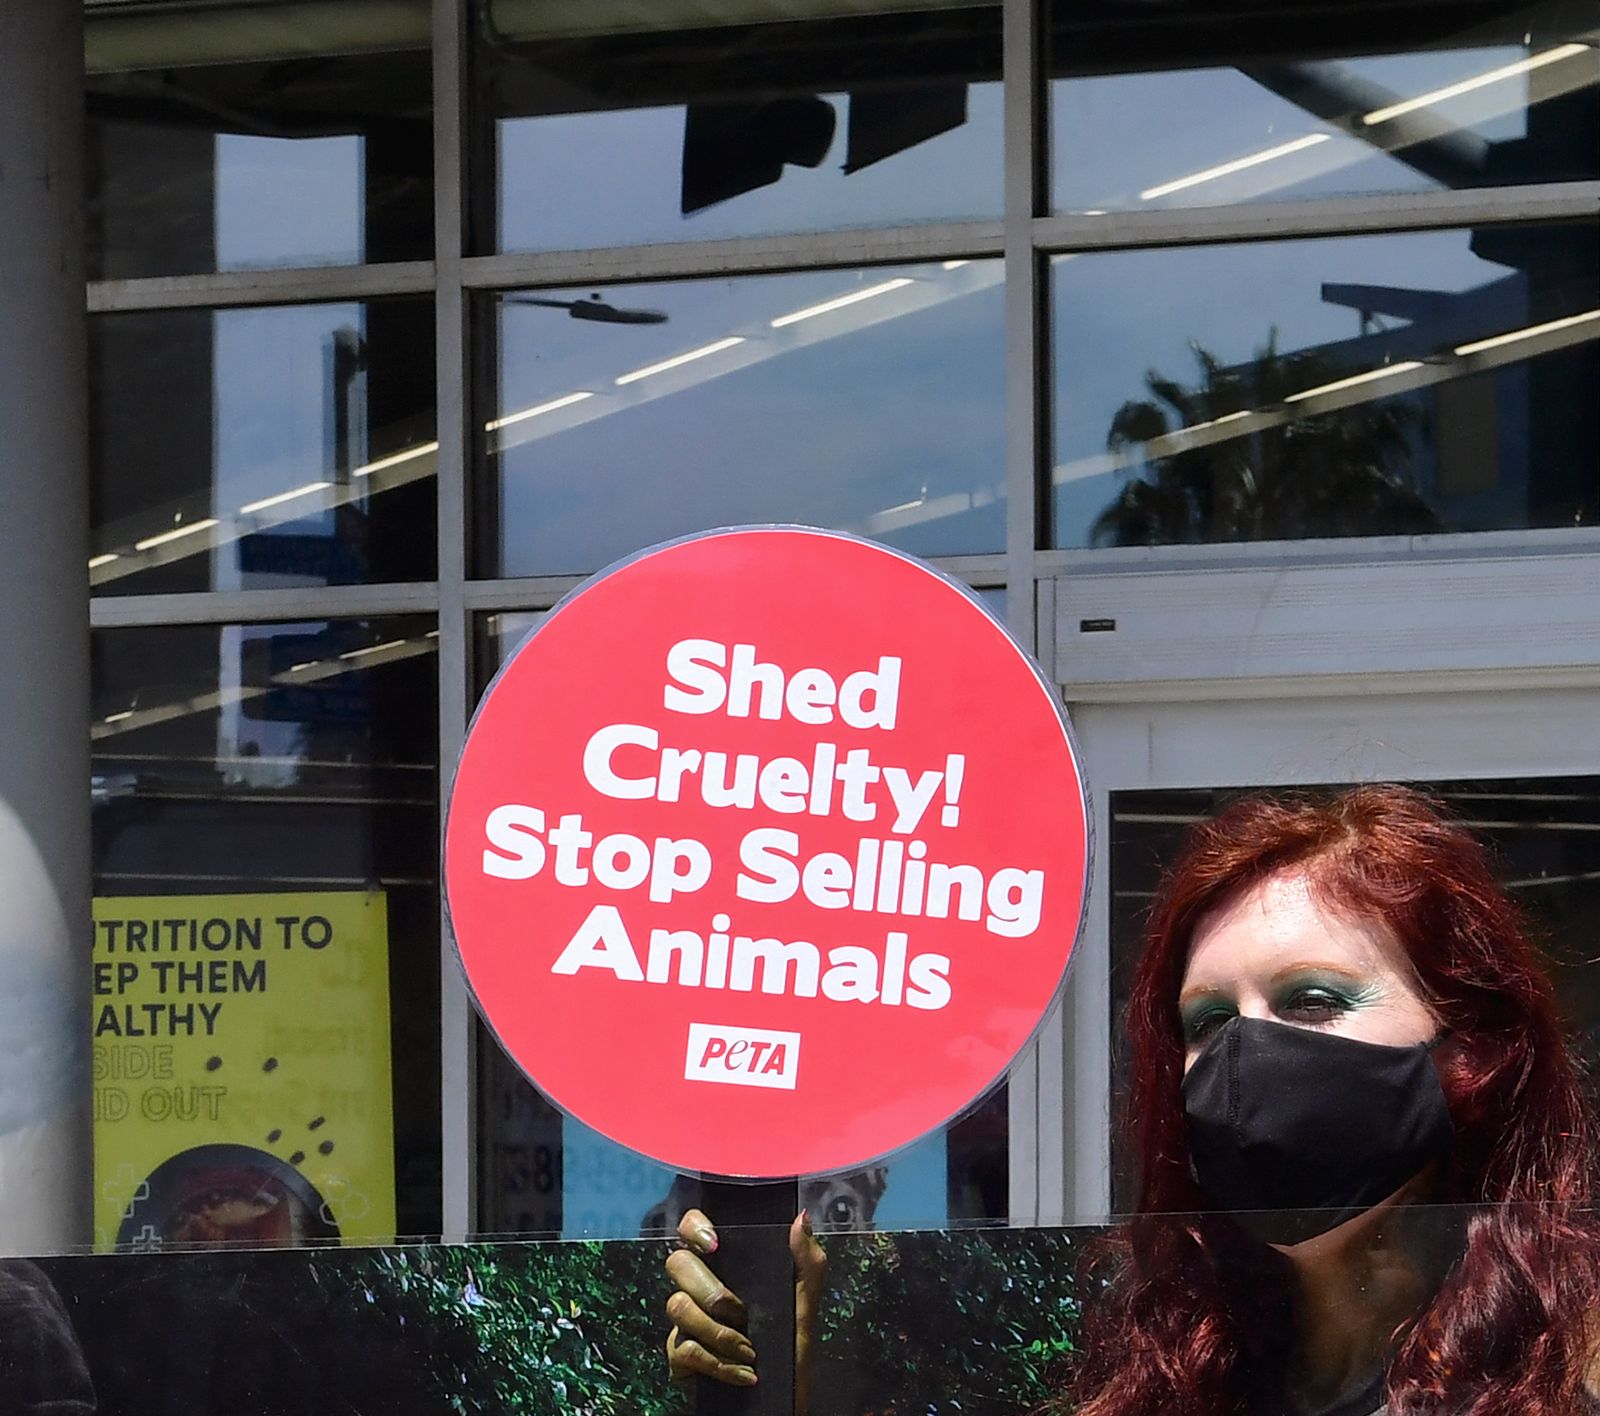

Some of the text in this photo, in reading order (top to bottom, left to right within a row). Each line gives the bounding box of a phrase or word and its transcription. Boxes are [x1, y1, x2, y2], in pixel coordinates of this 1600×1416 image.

[664, 638, 902, 730] Shed
[583, 723, 965, 835] Cruelty!
[482, 804, 1045, 938] Stop Selling
[92, 915, 334, 953] TRITION TO
[551, 904, 953, 1010] Animals
[93, 959, 267, 995] EP THEM
[94, 1002, 223, 1037] ALTHY
[92, 1044, 175, 1080] SIDE
[141, 1085, 228, 1121] OUT
